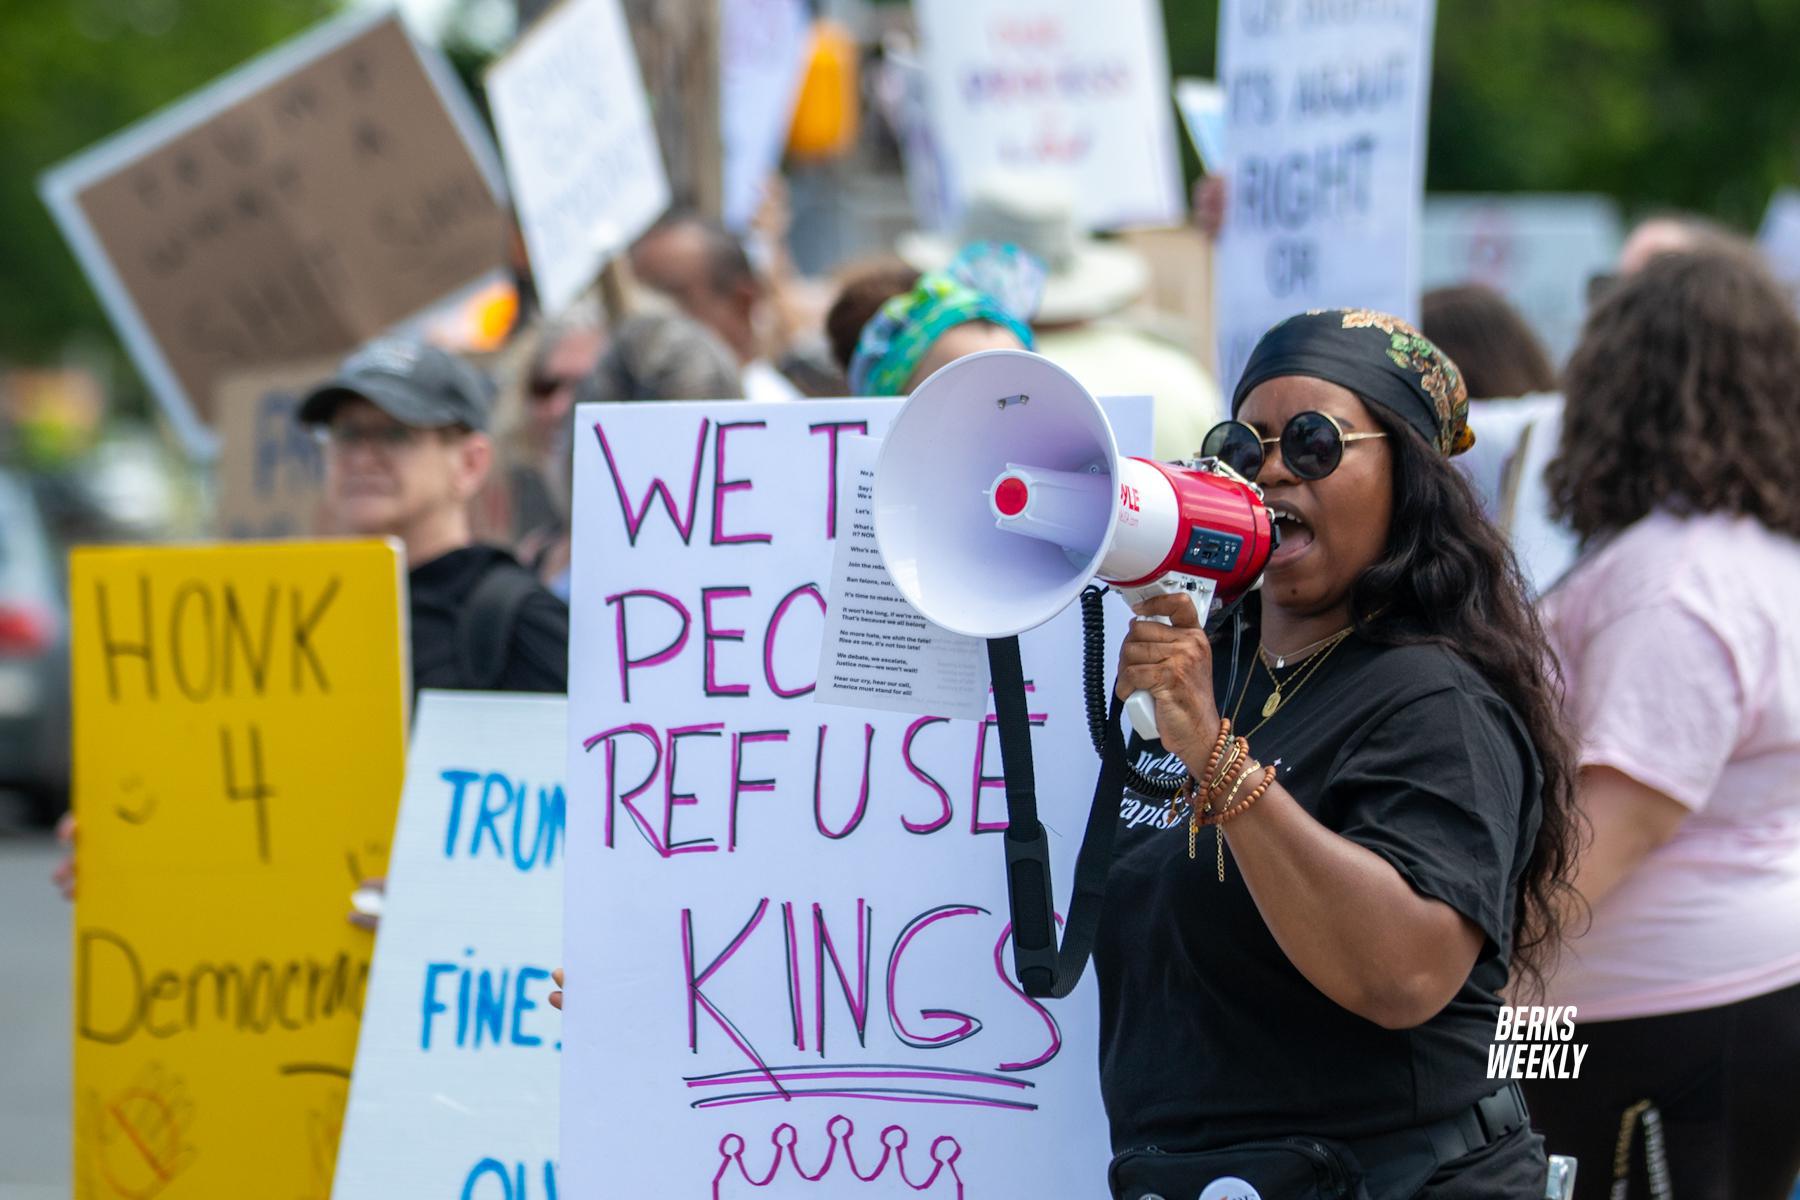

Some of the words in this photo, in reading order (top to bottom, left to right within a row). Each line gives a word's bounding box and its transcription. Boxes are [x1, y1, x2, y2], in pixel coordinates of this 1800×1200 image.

[1236, 132, 1377, 231] RIGHT
[1265, 237, 1319, 299] OR
[592, 417, 773, 547] WE
[1120, 483, 1140, 512] YLE
[94, 572, 343, 705] HONK
[219, 721, 280, 864] 4
[583, 713, 1049, 858] REFUSE
[681, 897, 1064, 1100] KINGS
